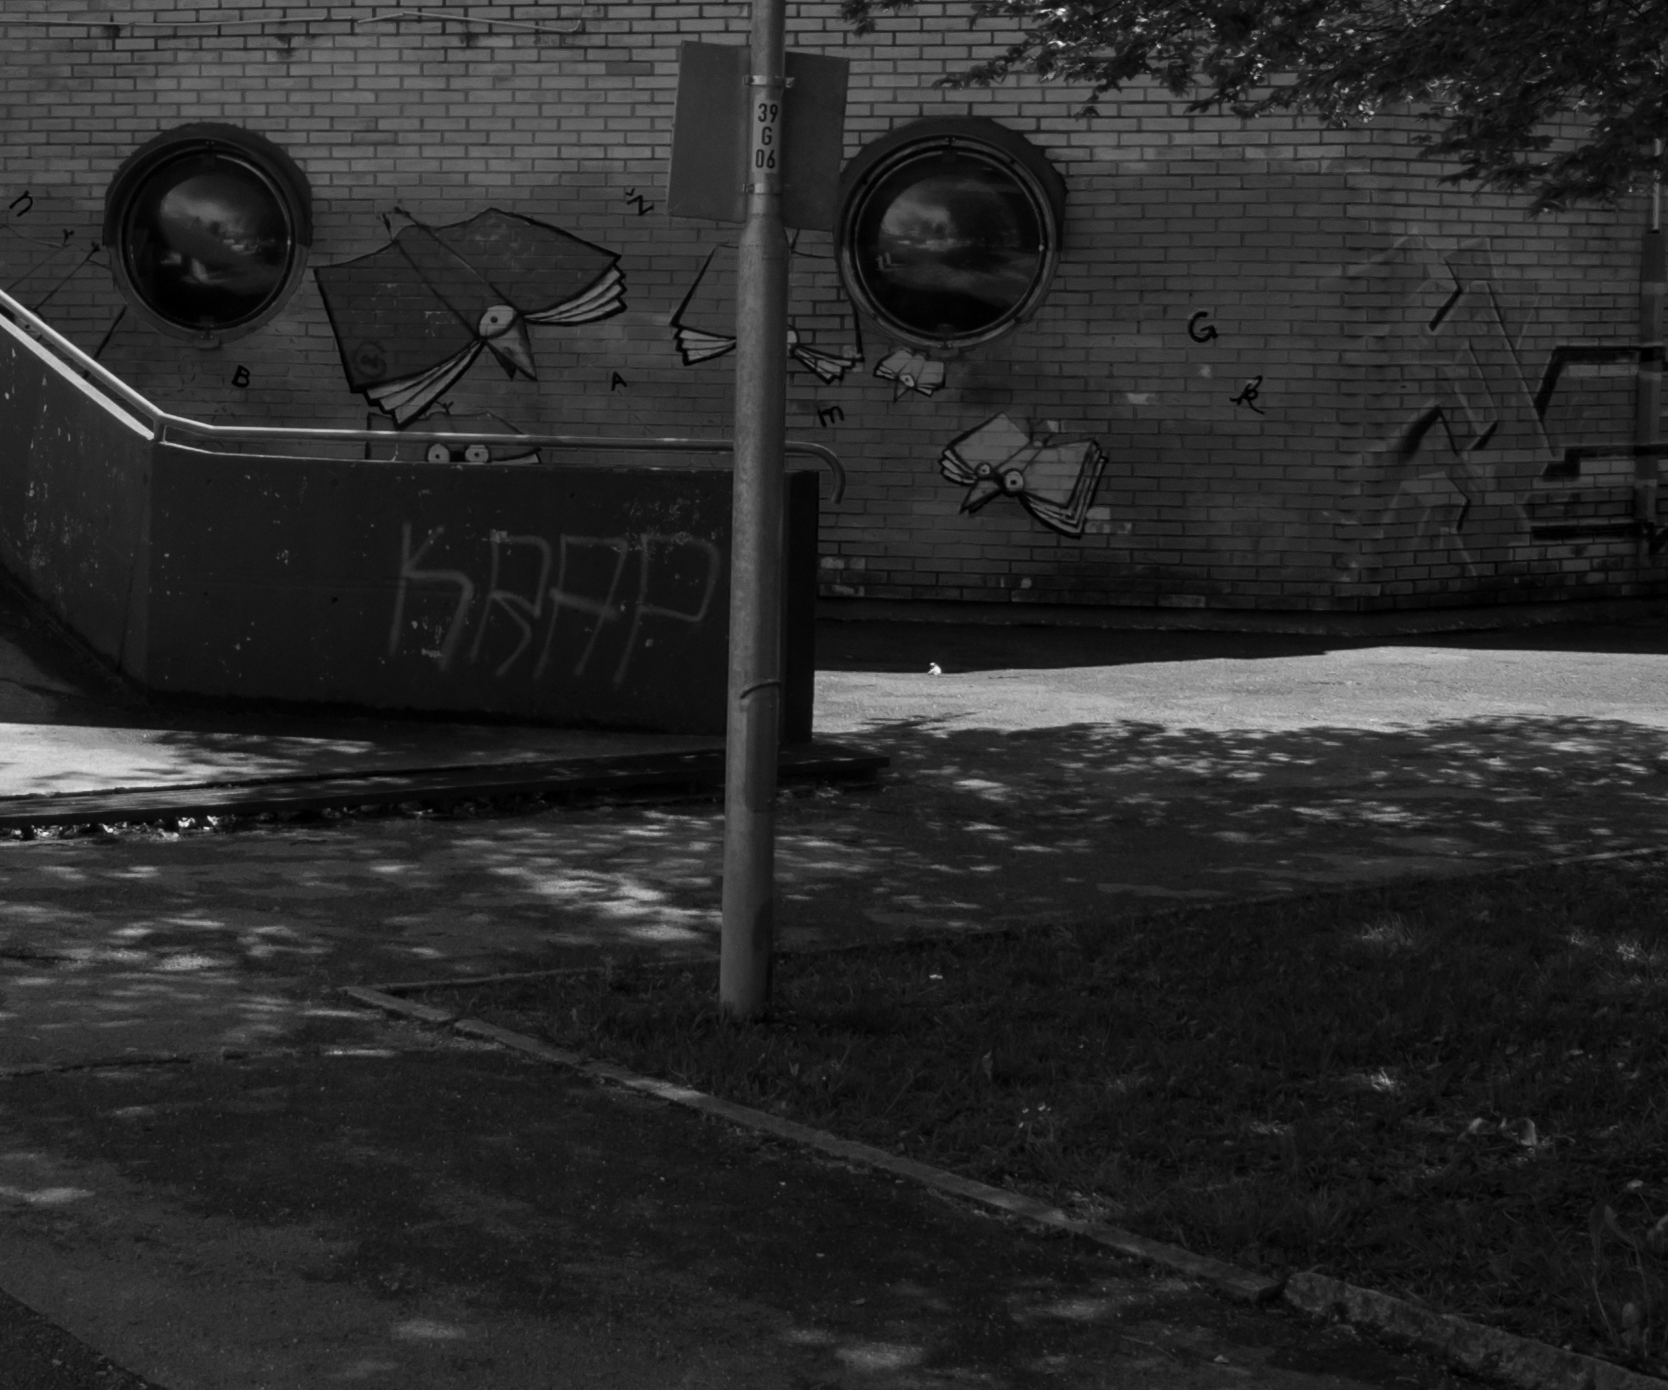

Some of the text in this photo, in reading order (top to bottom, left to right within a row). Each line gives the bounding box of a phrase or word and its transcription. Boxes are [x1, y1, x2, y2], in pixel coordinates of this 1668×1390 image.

[757, 102, 779, 124] 39
[761, 125, 773, 146] G
[755, 148, 776, 169] 06
[1188, 311, 1218, 343] G
[231, 364, 250, 388] B
[611, 371, 628, 391] A
